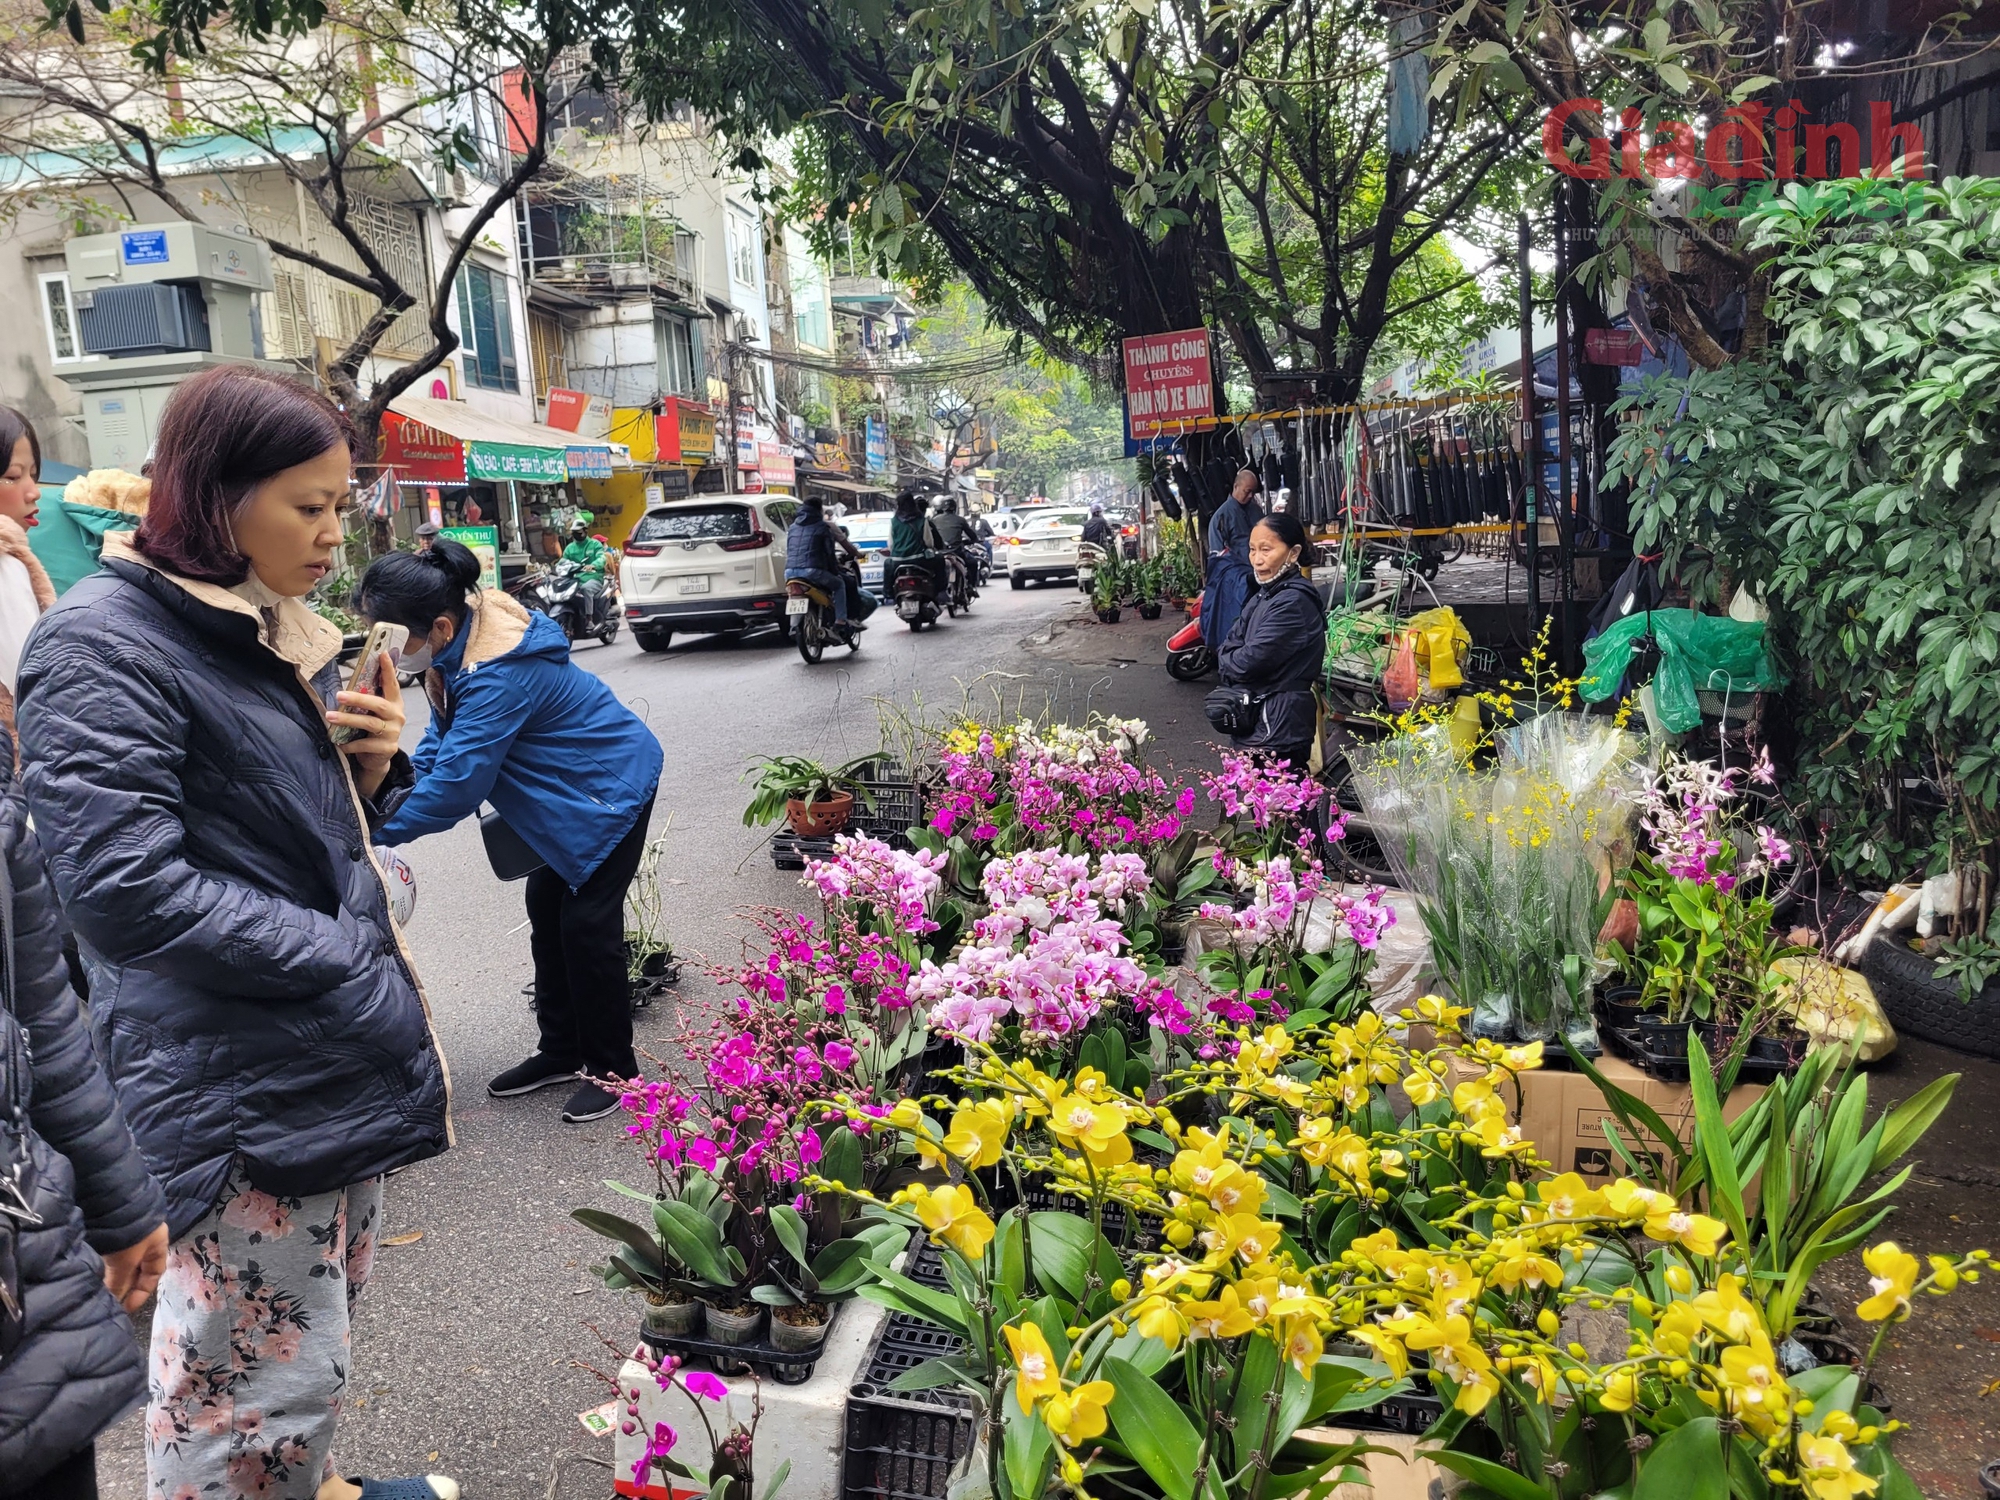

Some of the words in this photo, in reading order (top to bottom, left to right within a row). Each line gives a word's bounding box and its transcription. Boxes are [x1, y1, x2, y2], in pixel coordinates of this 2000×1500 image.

[1128, 343, 1169, 367] THÀNH
[1171, 338, 1206, 361] CÔNG
[1143, 365, 1194, 381] CHUYÊN:
[1130, 387, 1152, 416] HÀN
[1170, 386, 1185, 411] XE
[1186, 379, 1209, 410] MÁY
[456, 530, 473, 540] YẾN
[474, 530, 492, 540] THƯ
